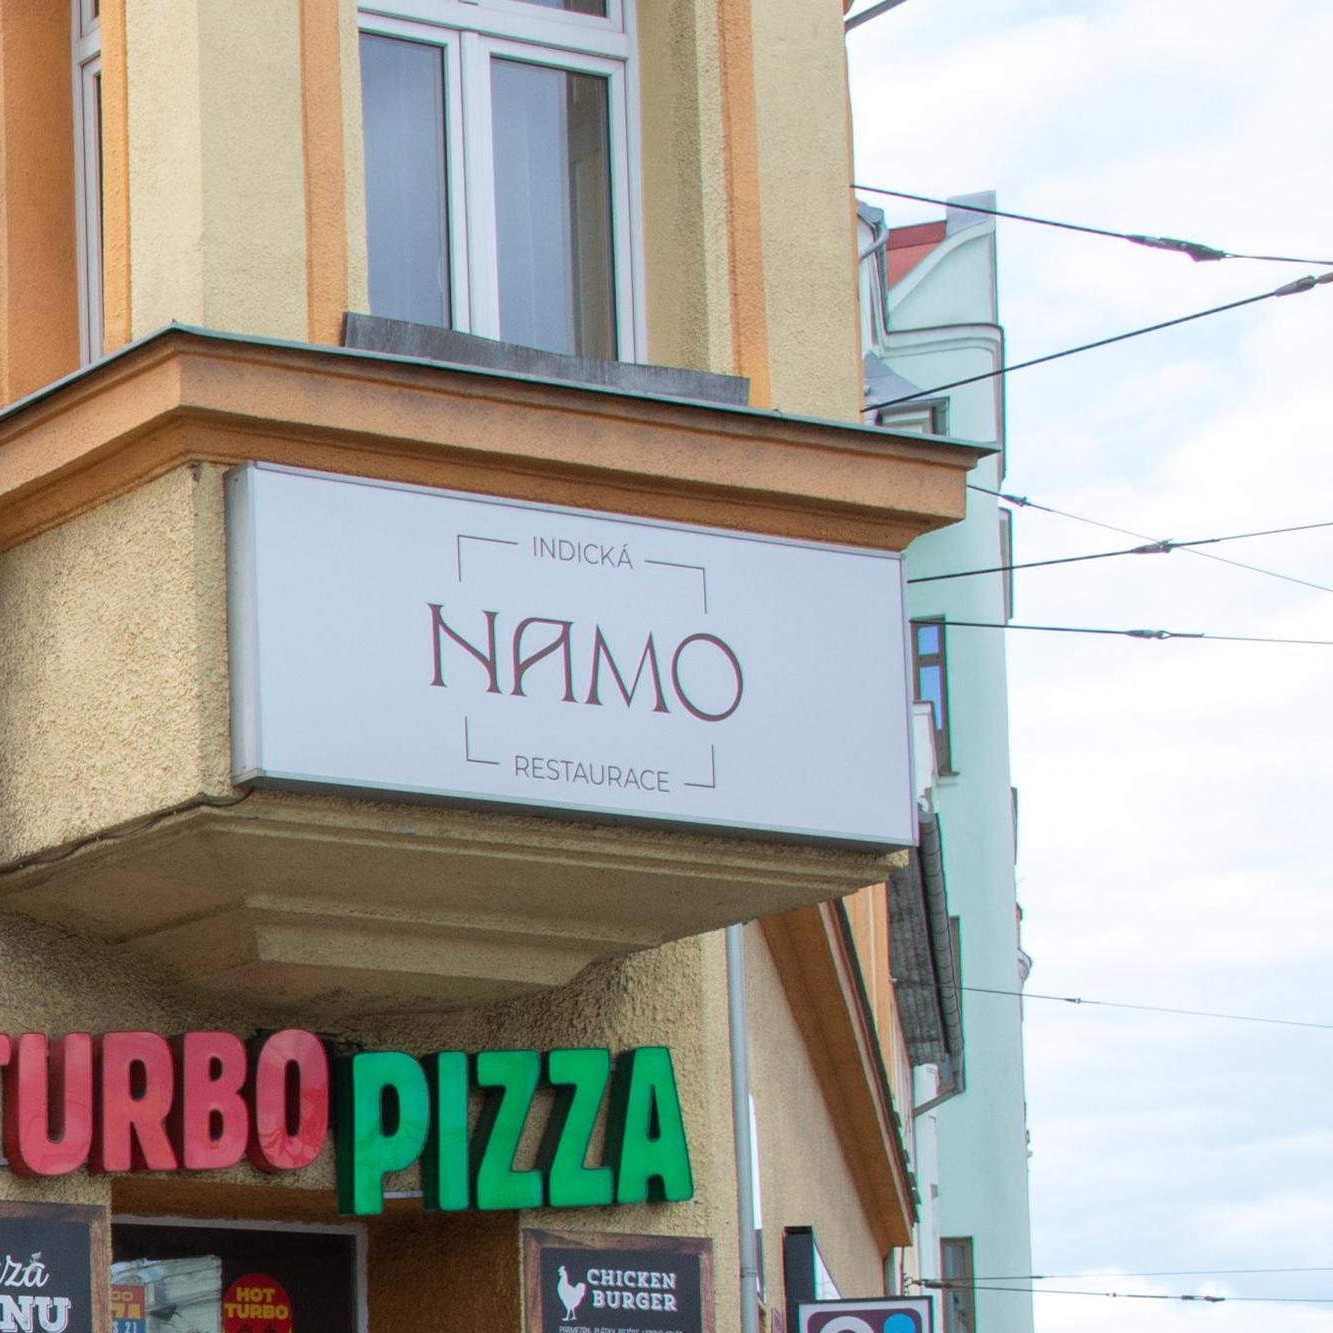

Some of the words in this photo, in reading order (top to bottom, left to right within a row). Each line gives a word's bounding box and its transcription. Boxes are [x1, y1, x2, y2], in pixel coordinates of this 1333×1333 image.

[532, 533, 635, 570] INDICKÁ
[427, 602, 744, 722] NAMO
[514, 754, 671, 794] RESTAURACE
[336, 1045, 695, 1216] PIZZA
[235, 1287, 276, 1302] HOT
[586, 1268, 677, 1291] CHICKEN
[224, 1303, 289, 1321] TURBO
[591, 1290, 678, 1313] BURGER
